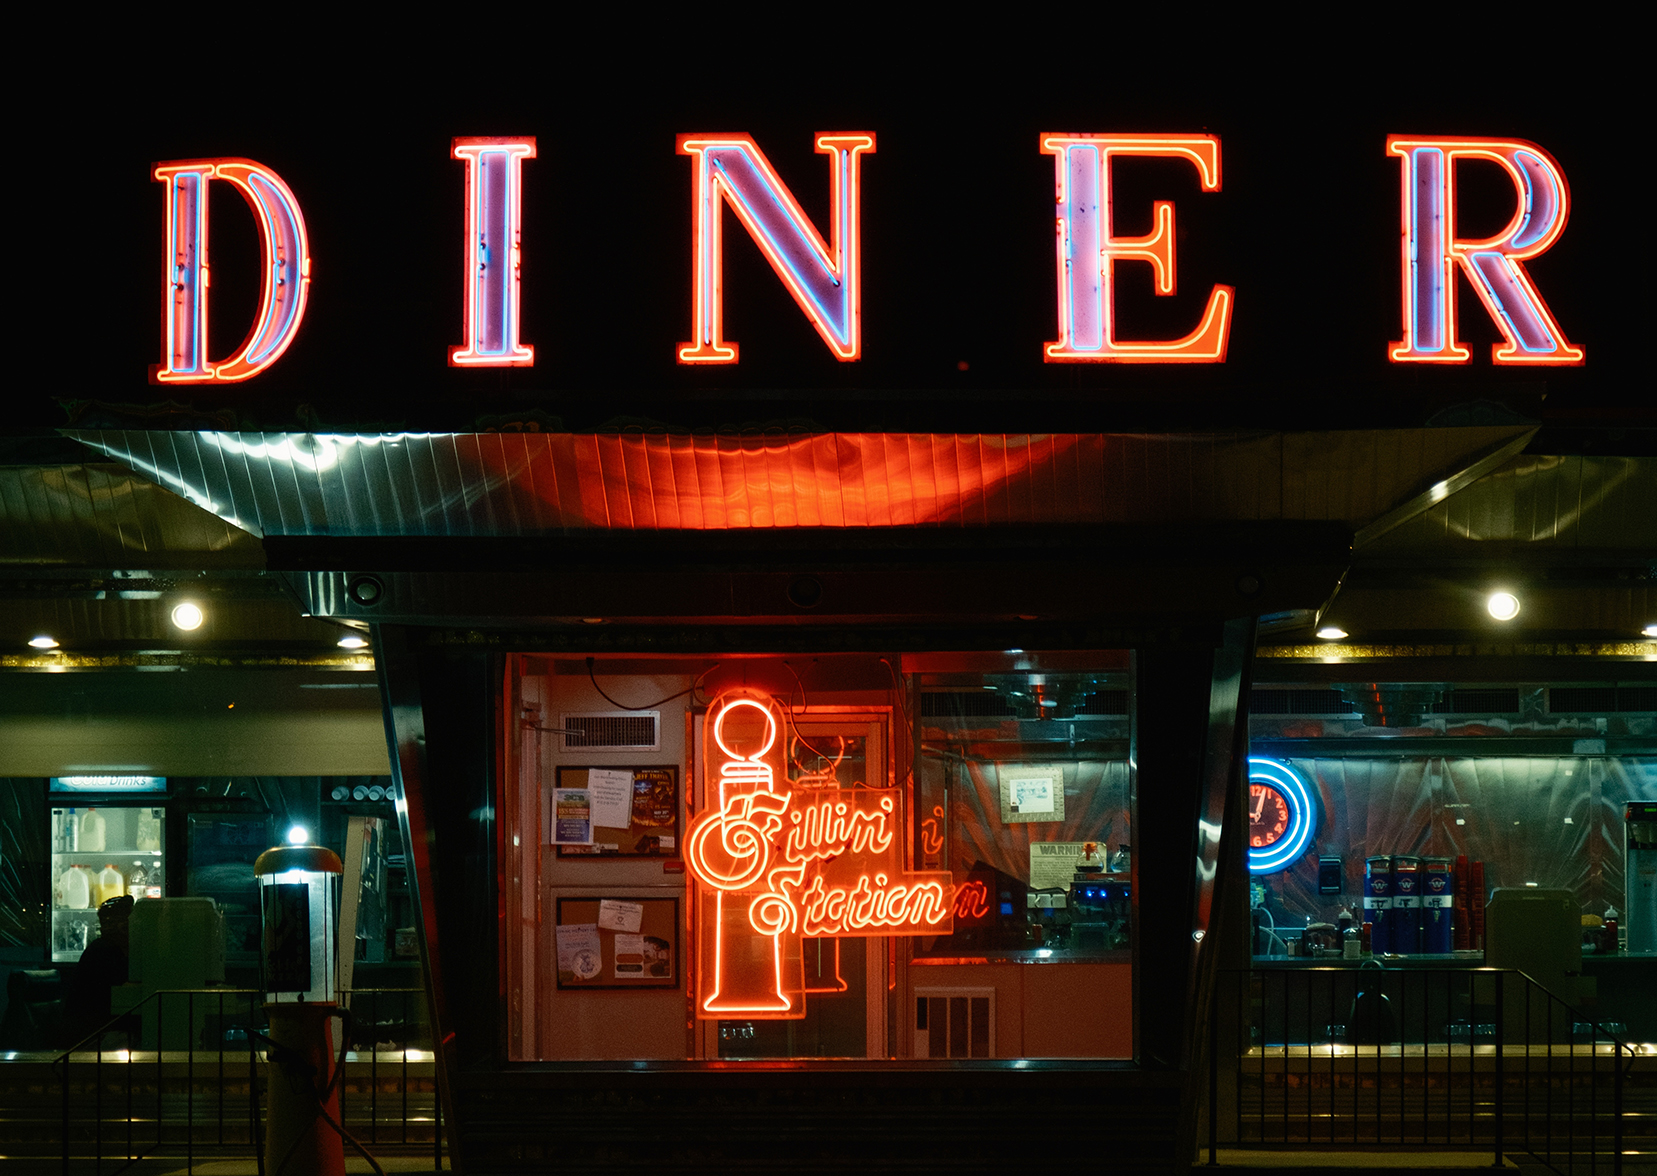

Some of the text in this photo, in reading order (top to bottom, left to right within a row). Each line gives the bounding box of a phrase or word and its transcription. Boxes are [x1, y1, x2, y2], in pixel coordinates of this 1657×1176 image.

[149, 132, 1585, 385] DINER
[1275, 798, 1284, 809] 2
[1278, 810, 1288, 822] 3
[1274, 823, 1284, 834] 4
[1253, 836, 1263, 847] 6
[1266, 832, 1275, 844] 5
[1040, 845, 1085, 855] WARNIN
[749, 861, 947, 936] Station
